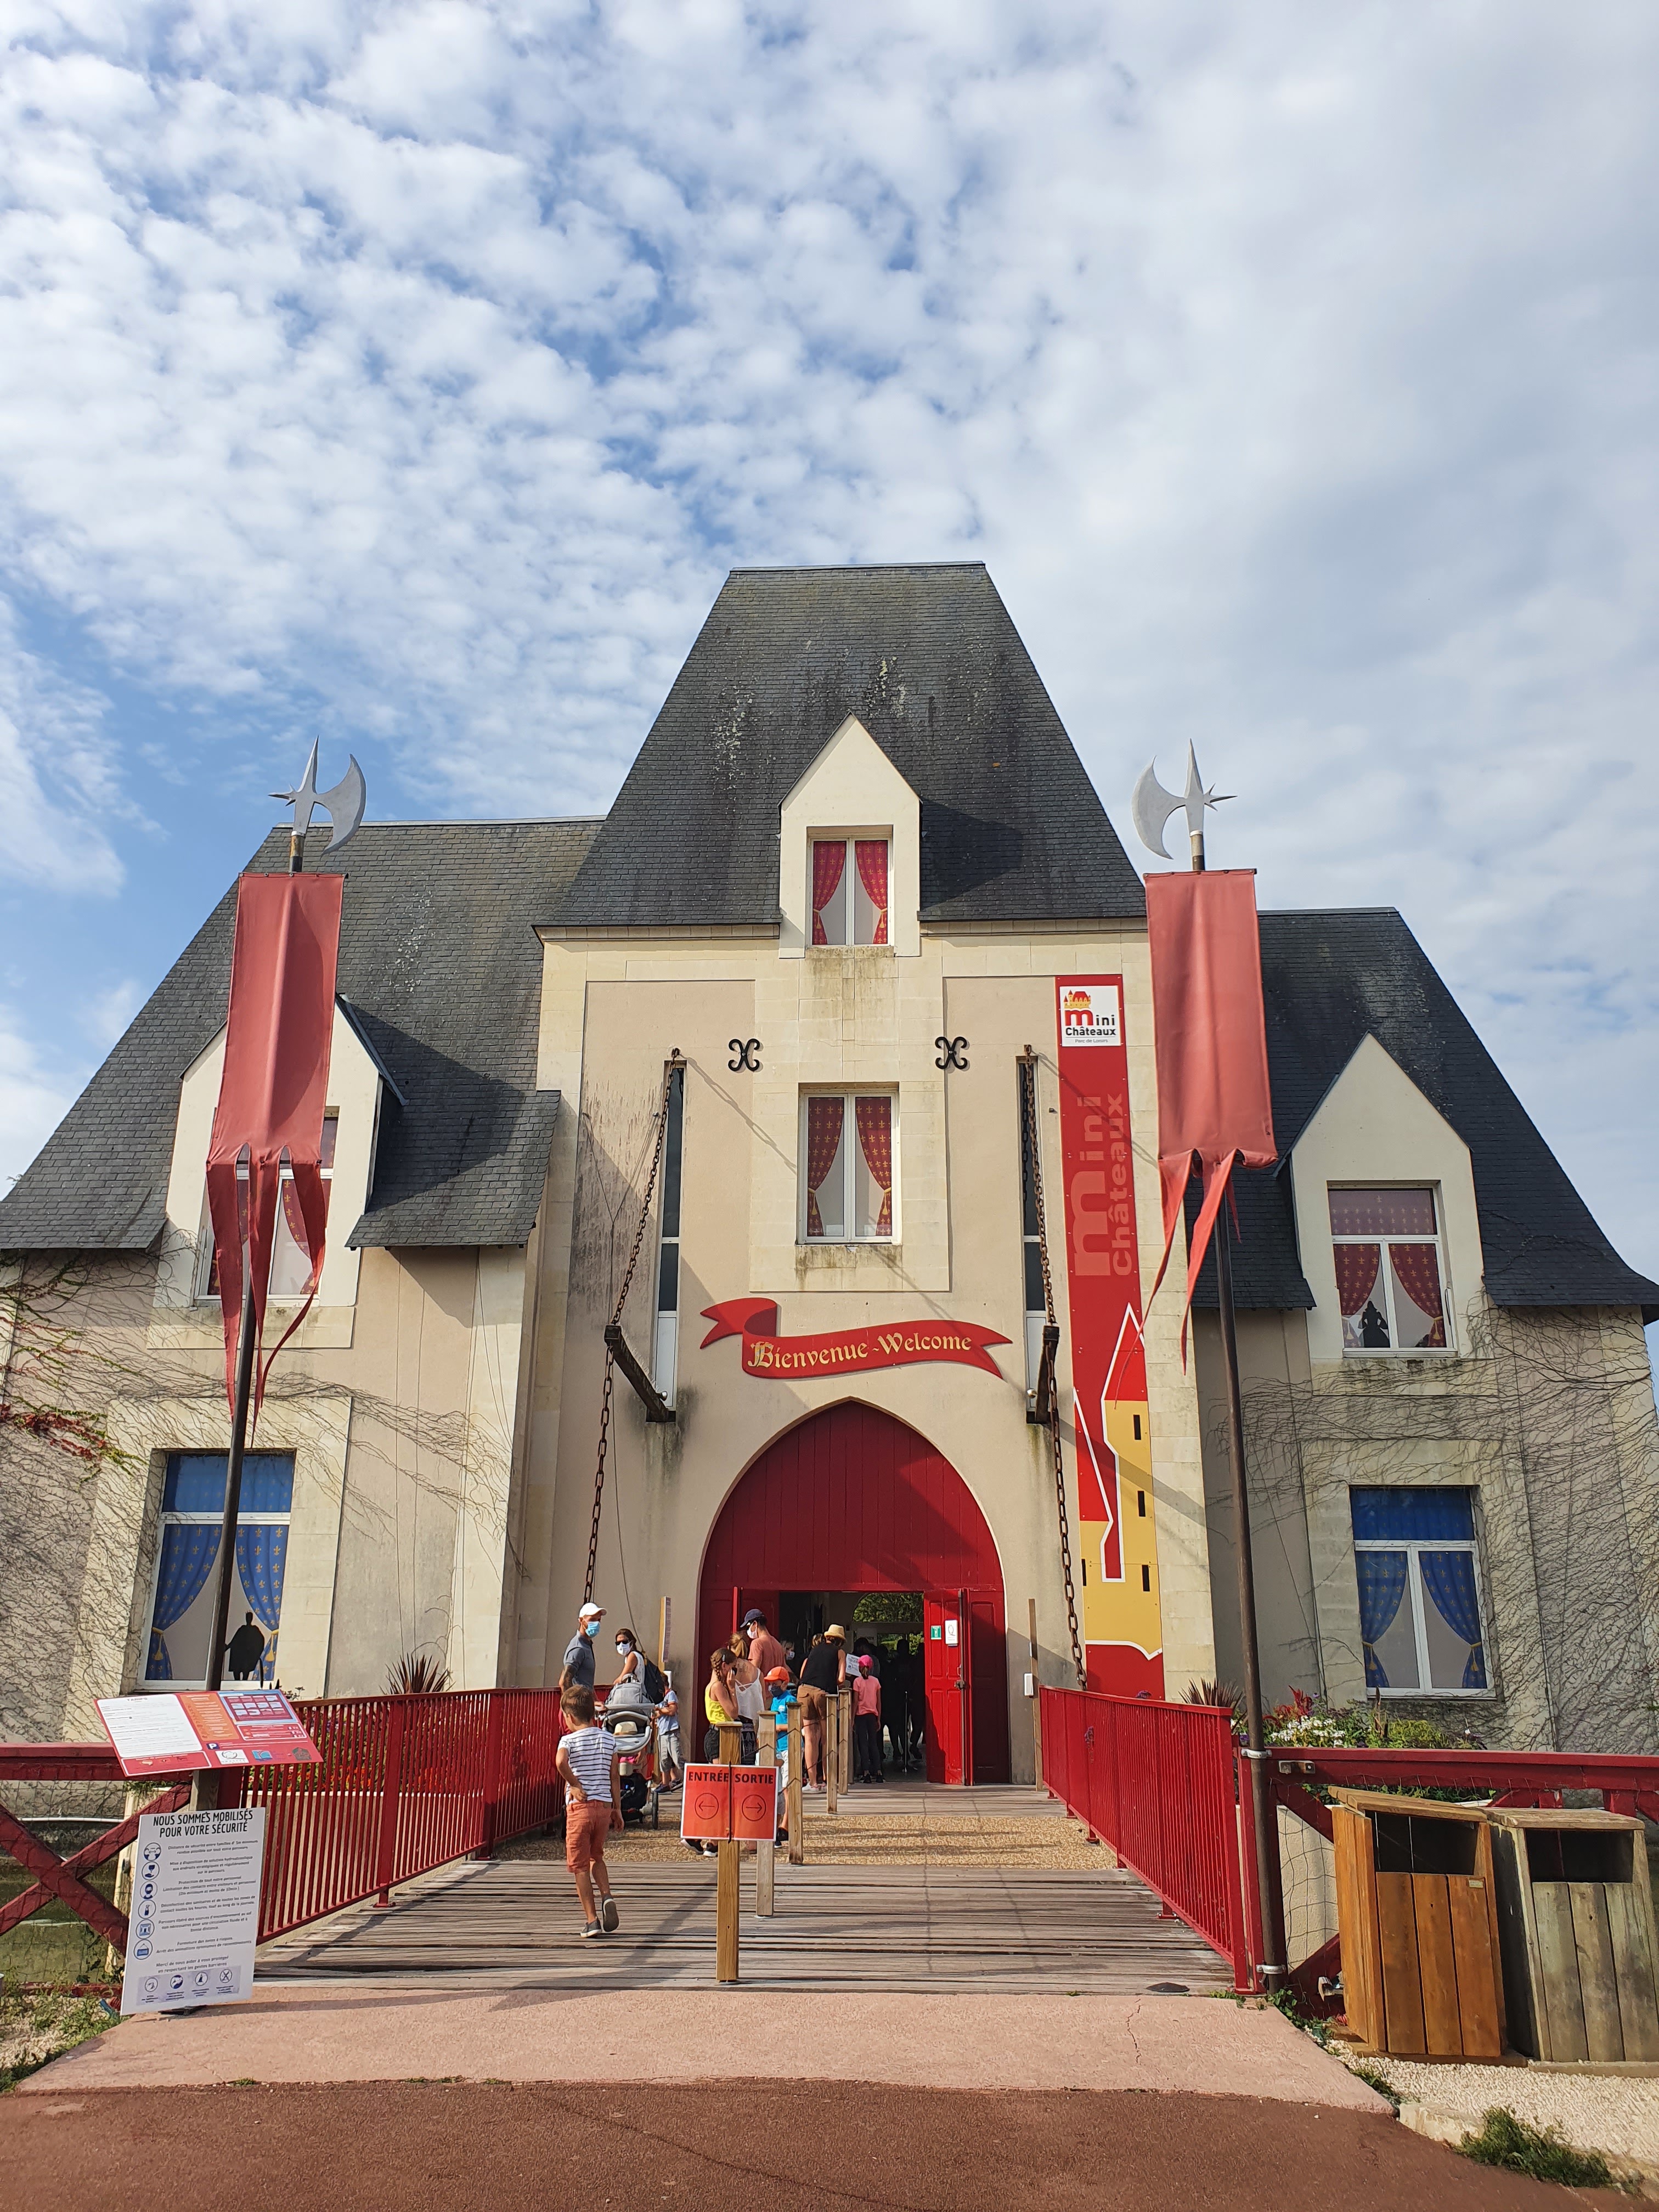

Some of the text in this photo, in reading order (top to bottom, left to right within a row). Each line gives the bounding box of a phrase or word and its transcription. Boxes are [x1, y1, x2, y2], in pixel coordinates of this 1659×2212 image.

[1064, 1010, 1115, 1026] mini
[1065, 1026, 1116, 1036] Châteaux
[1070, 1096, 1111, 1276] mini
[1107, 1093, 1132, 1276] Châteaux
[747, 1332, 972, 1368] Bienvenue Welcome
[689, 1770, 774, 1784] ENTRÉE SORTIE
[153, 1809, 253, 1826] NOUS SOMMES MOBILISÉS
[160, 1820, 248, 1838] POUR VOTRE SÉCURITÉ
